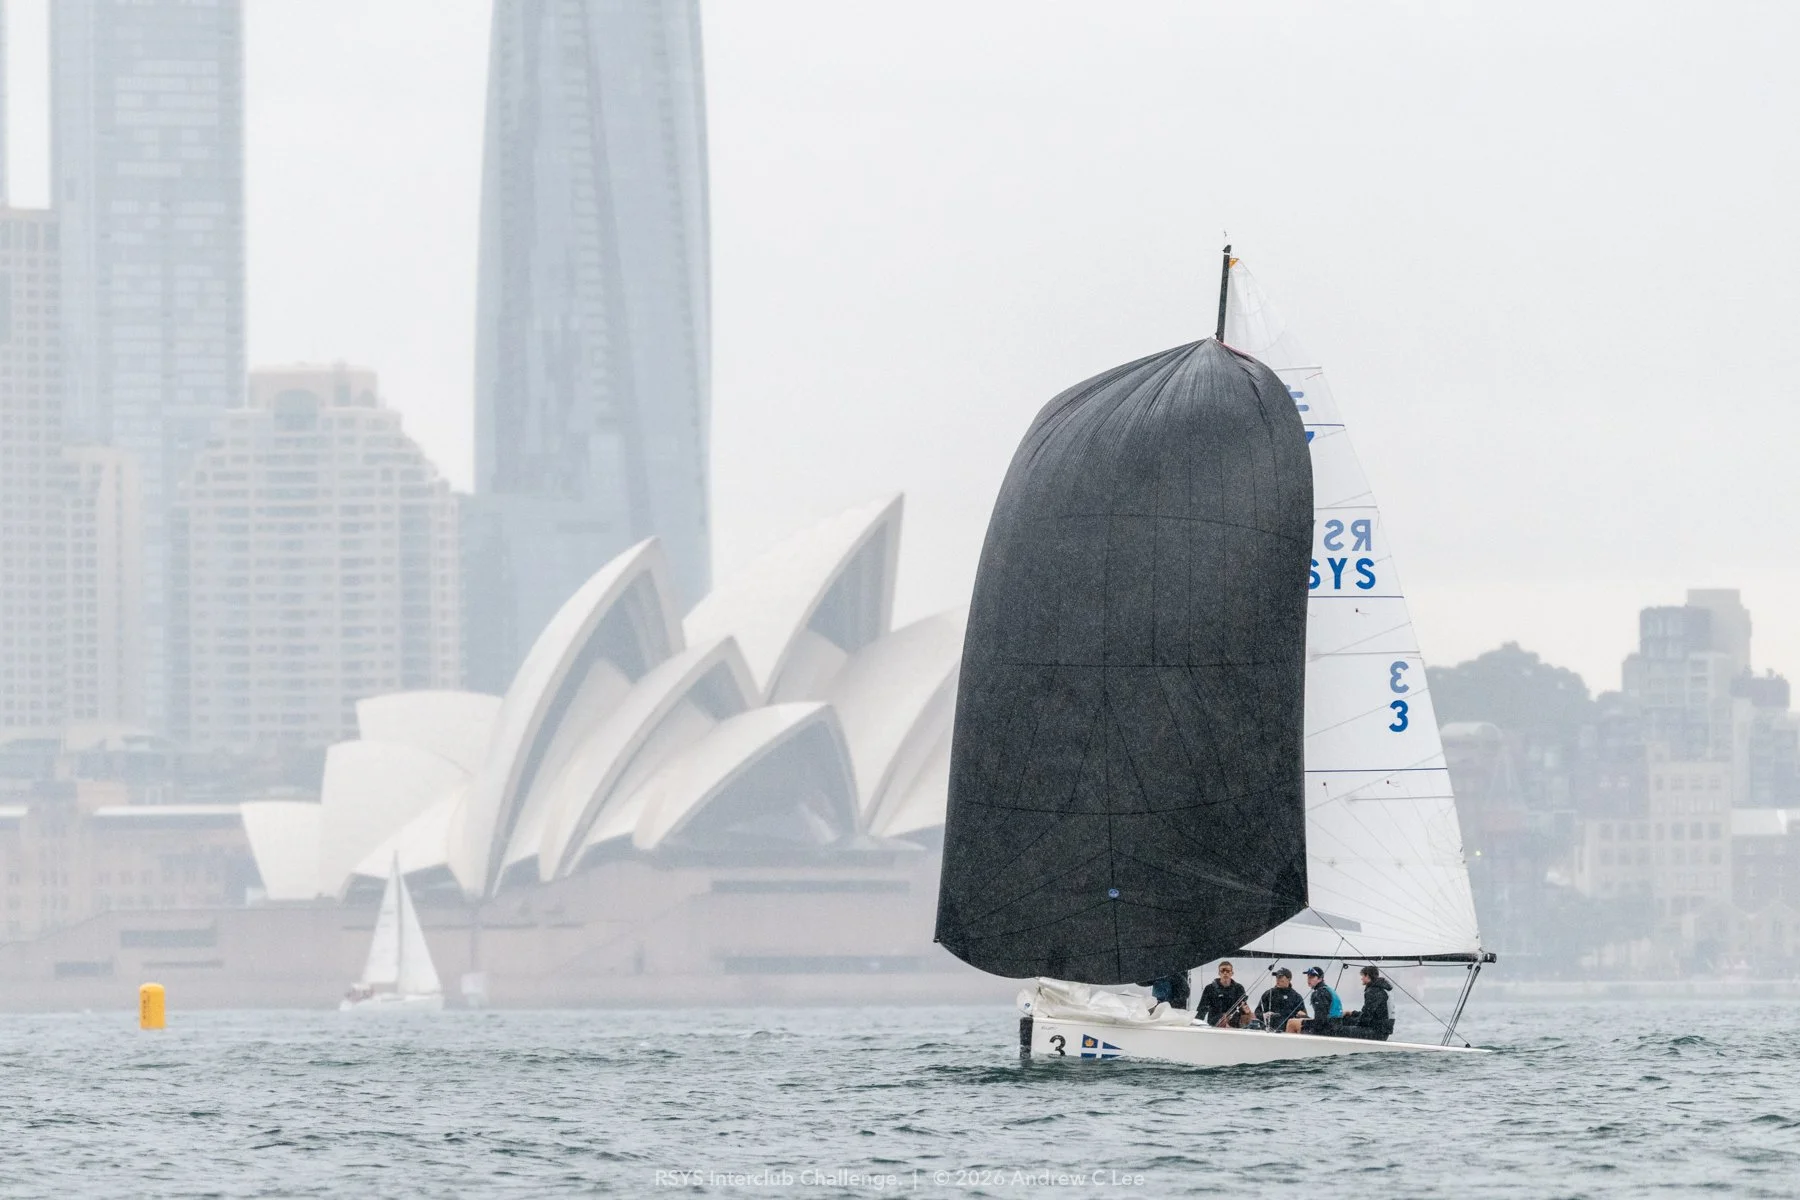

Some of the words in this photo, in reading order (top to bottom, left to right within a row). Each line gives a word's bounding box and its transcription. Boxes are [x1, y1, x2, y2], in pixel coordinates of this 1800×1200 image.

[1308, 558, 1376, 589] SYS
[1389, 700, 1409, 732] 3
[1049, 1035, 1066, 1056] 3
